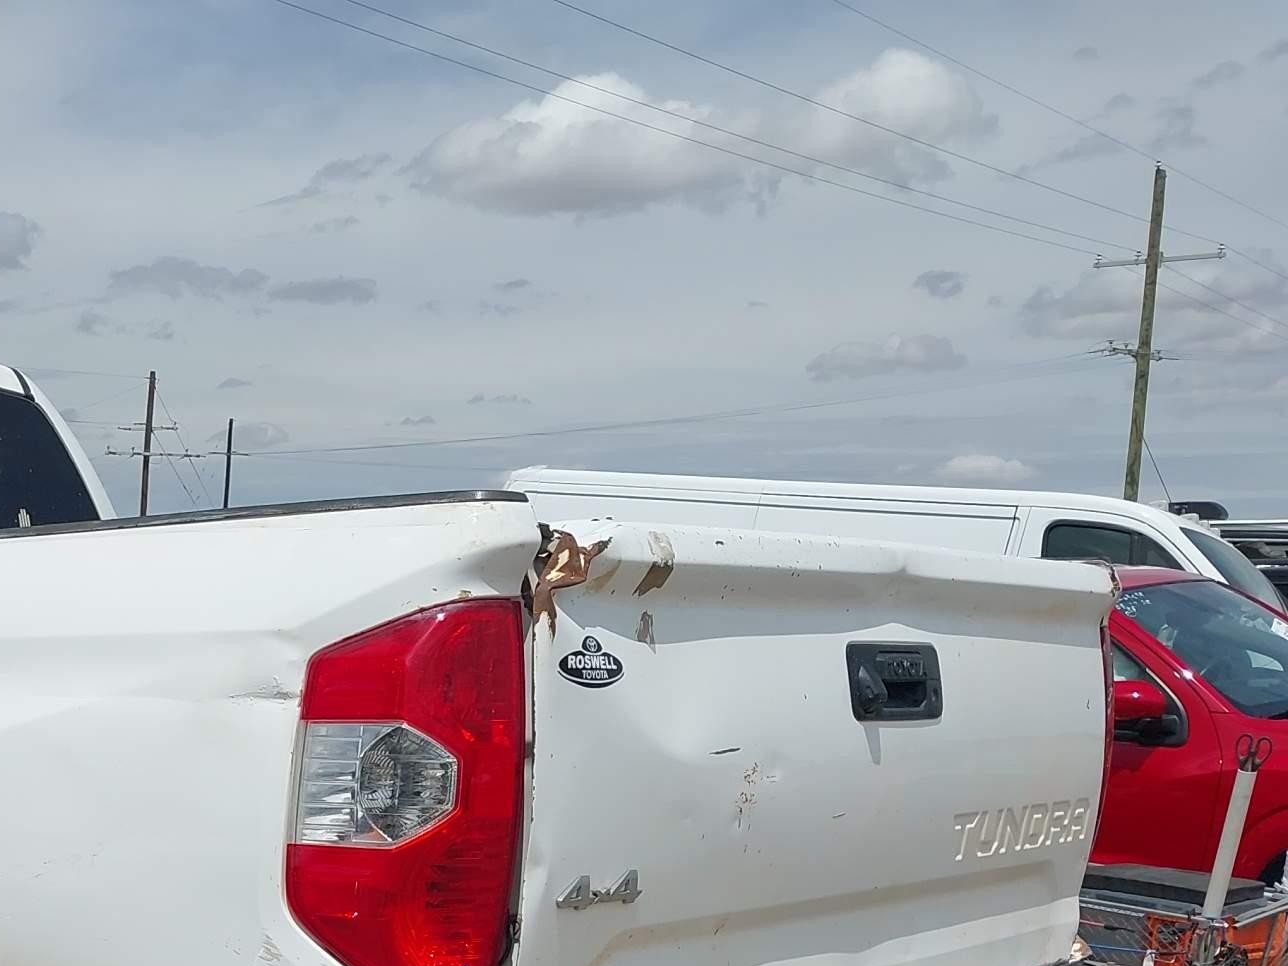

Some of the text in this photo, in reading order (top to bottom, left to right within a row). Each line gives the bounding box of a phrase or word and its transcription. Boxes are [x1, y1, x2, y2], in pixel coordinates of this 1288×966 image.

[567, 655, 618, 670] ROSWELL
[582, 669, 609, 679] TOYOTA
[953, 798, 1090, 861] TUNDRA
[556, 869, 643, 910] 4x4
